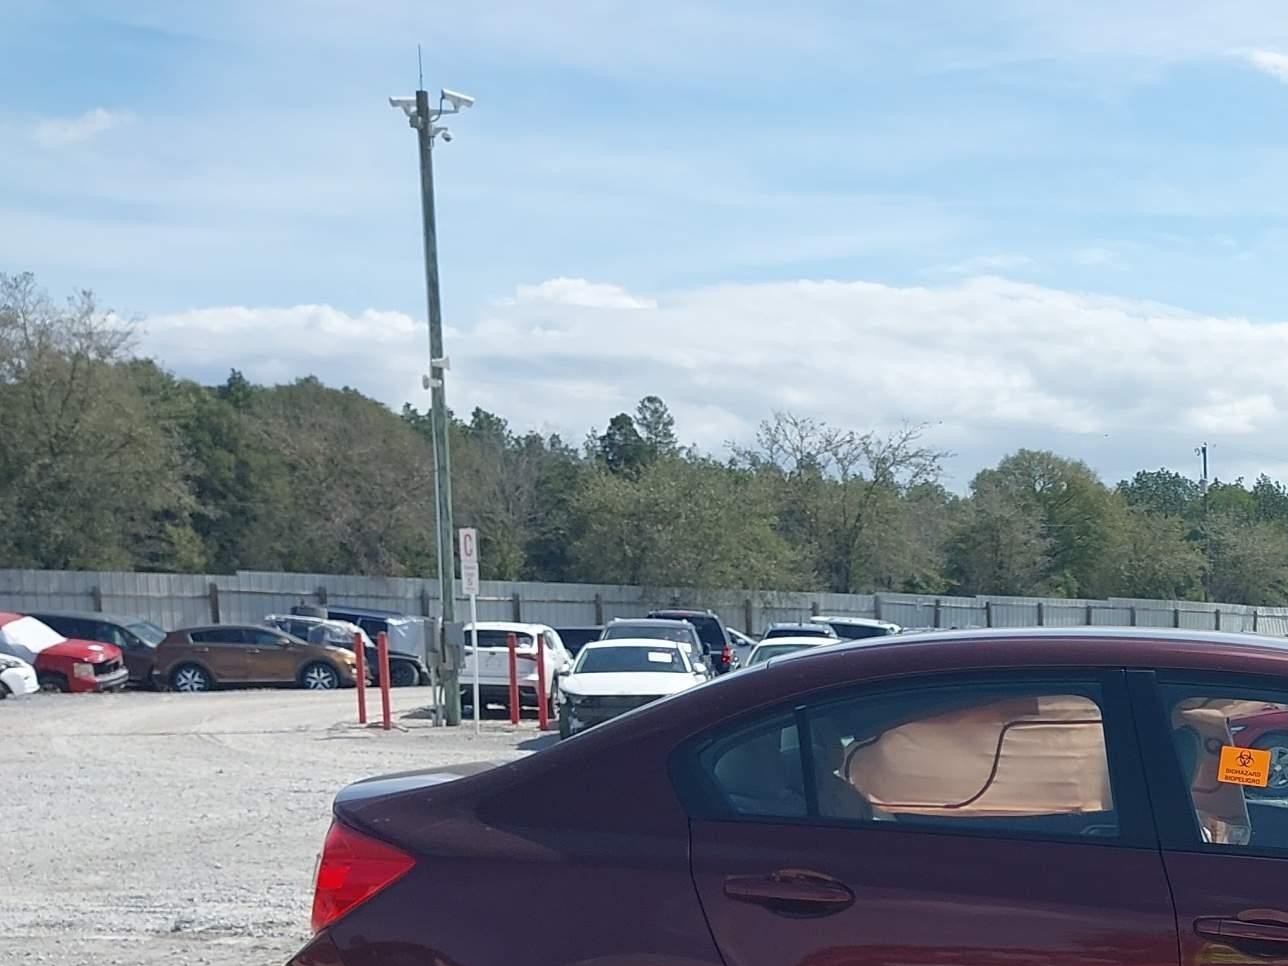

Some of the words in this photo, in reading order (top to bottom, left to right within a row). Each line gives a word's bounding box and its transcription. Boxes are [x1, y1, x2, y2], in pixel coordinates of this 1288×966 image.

[463, 534, 473, 557] C
[1225, 768, 1262, 778] BIOHAZARD
[1224, 775, 1261, 785] BIOPELIGRO
